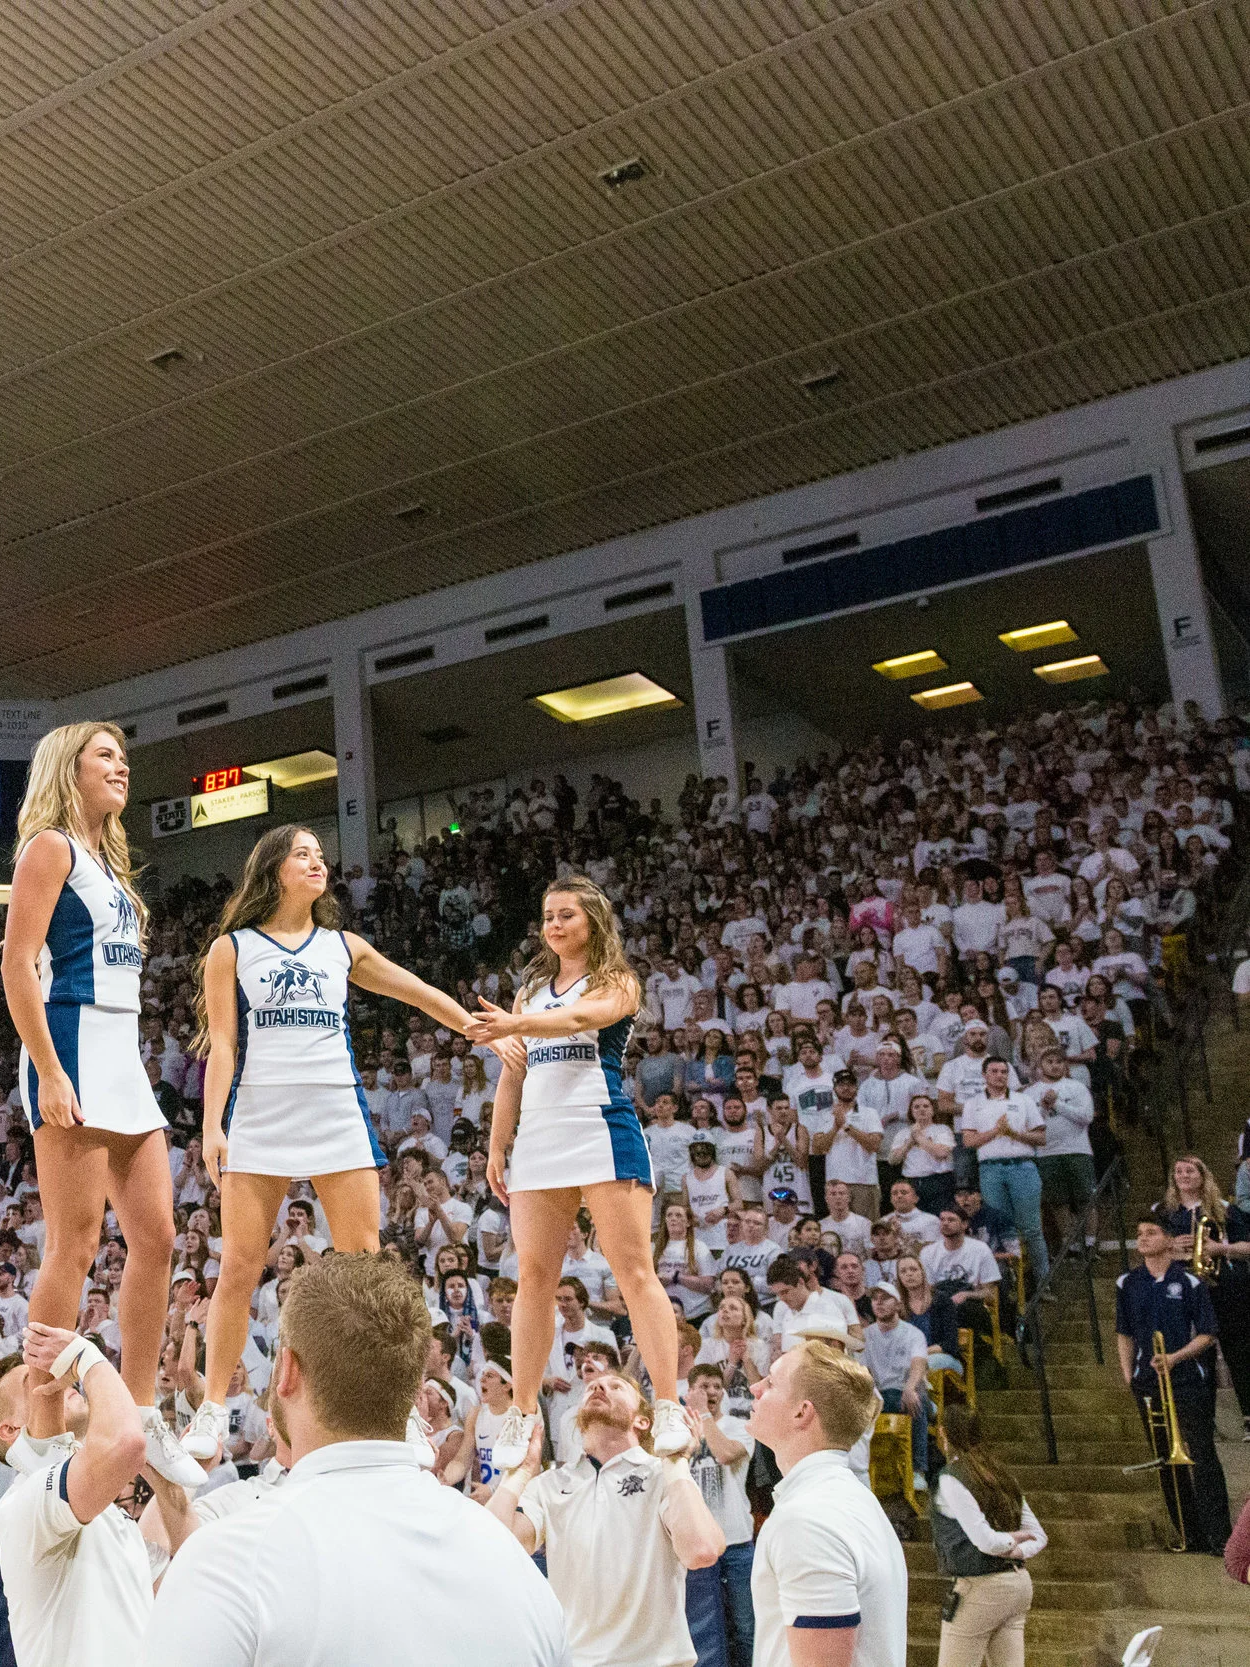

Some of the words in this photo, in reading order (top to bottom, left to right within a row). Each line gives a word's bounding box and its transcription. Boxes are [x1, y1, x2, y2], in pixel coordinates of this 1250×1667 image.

[2, 710, 21, 719] TEXT
[347, 800, 357, 816] E
[102, 942, 134, 966] UTAH
[254, 1008, 297, 1029] UTAH
[297, 1007, 340, 1031] STATE
[528, 1046, 551, 1069] TAH
[551, 1043, 596, 1061] STATE
[773, 1165, 795, 1183] 45
[726, 1254, 764, 1268] USU
